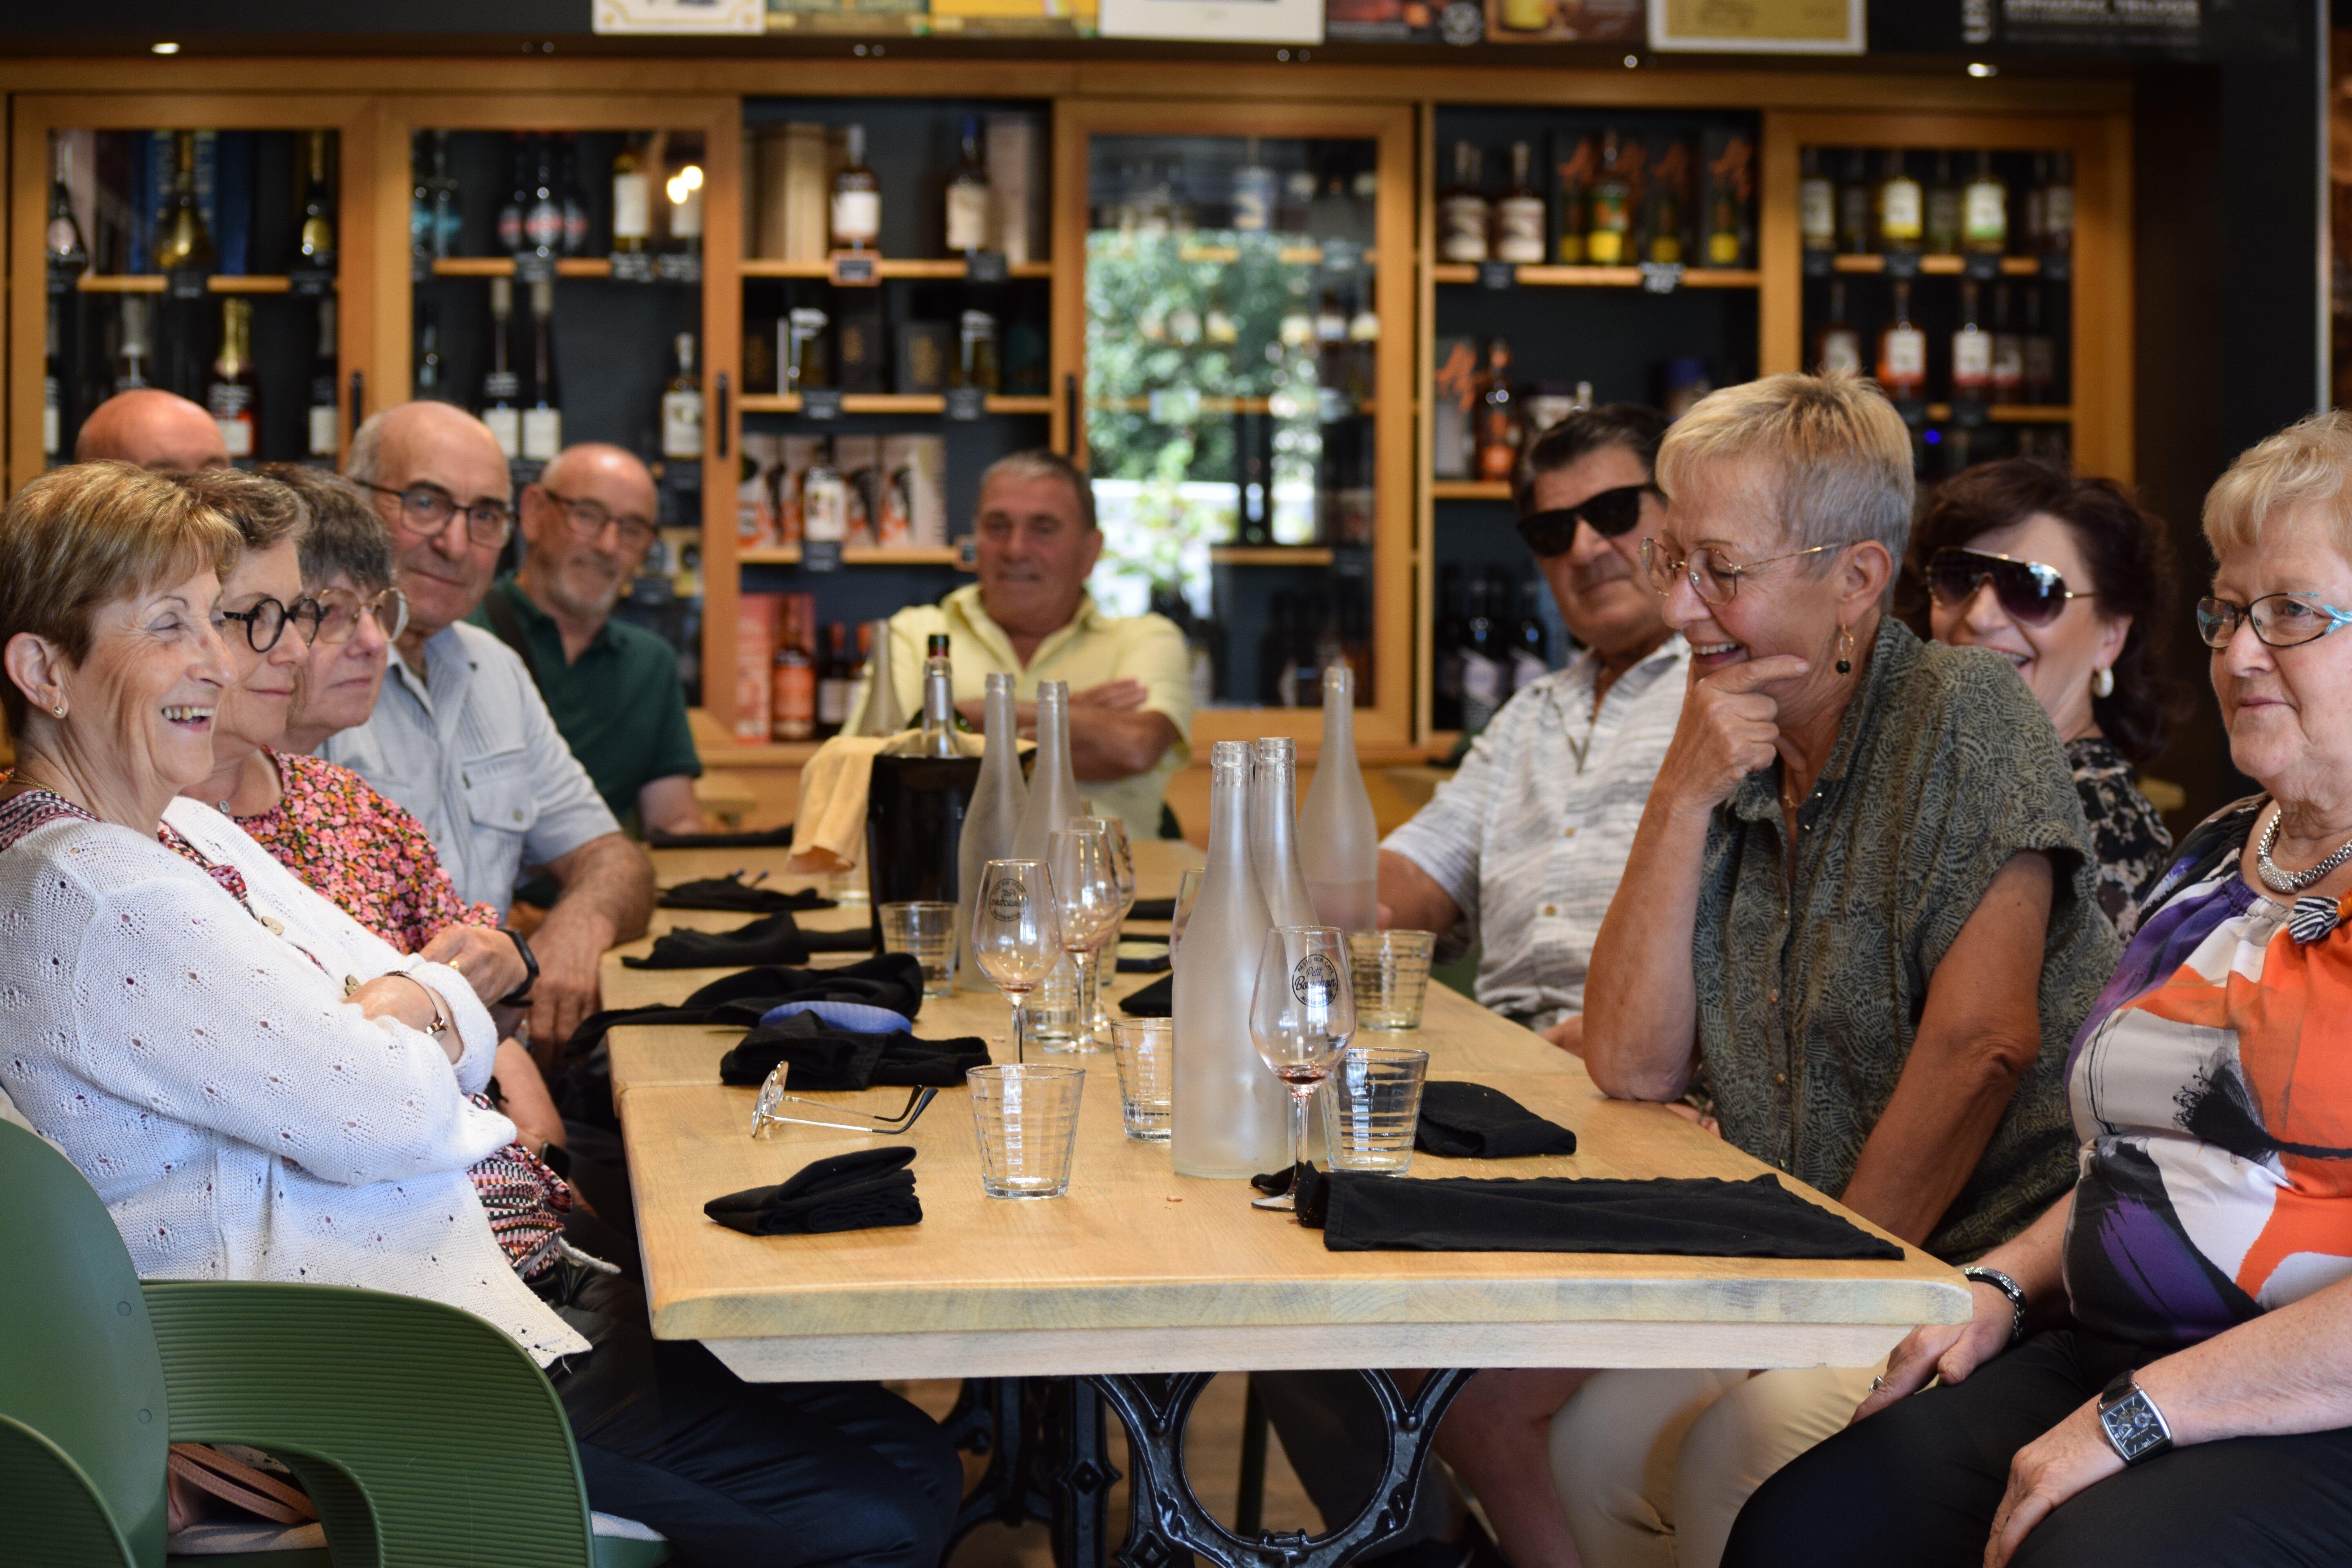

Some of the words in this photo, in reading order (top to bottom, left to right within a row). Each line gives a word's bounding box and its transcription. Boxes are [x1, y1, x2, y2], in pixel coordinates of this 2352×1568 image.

[1298, 958, 1312, 973] RESTO
[1325, 961, 1334, 974] CAVE
[1306, 966, 1323, 977] Petit
[1294, 975, 1336, 990] Bouchon
